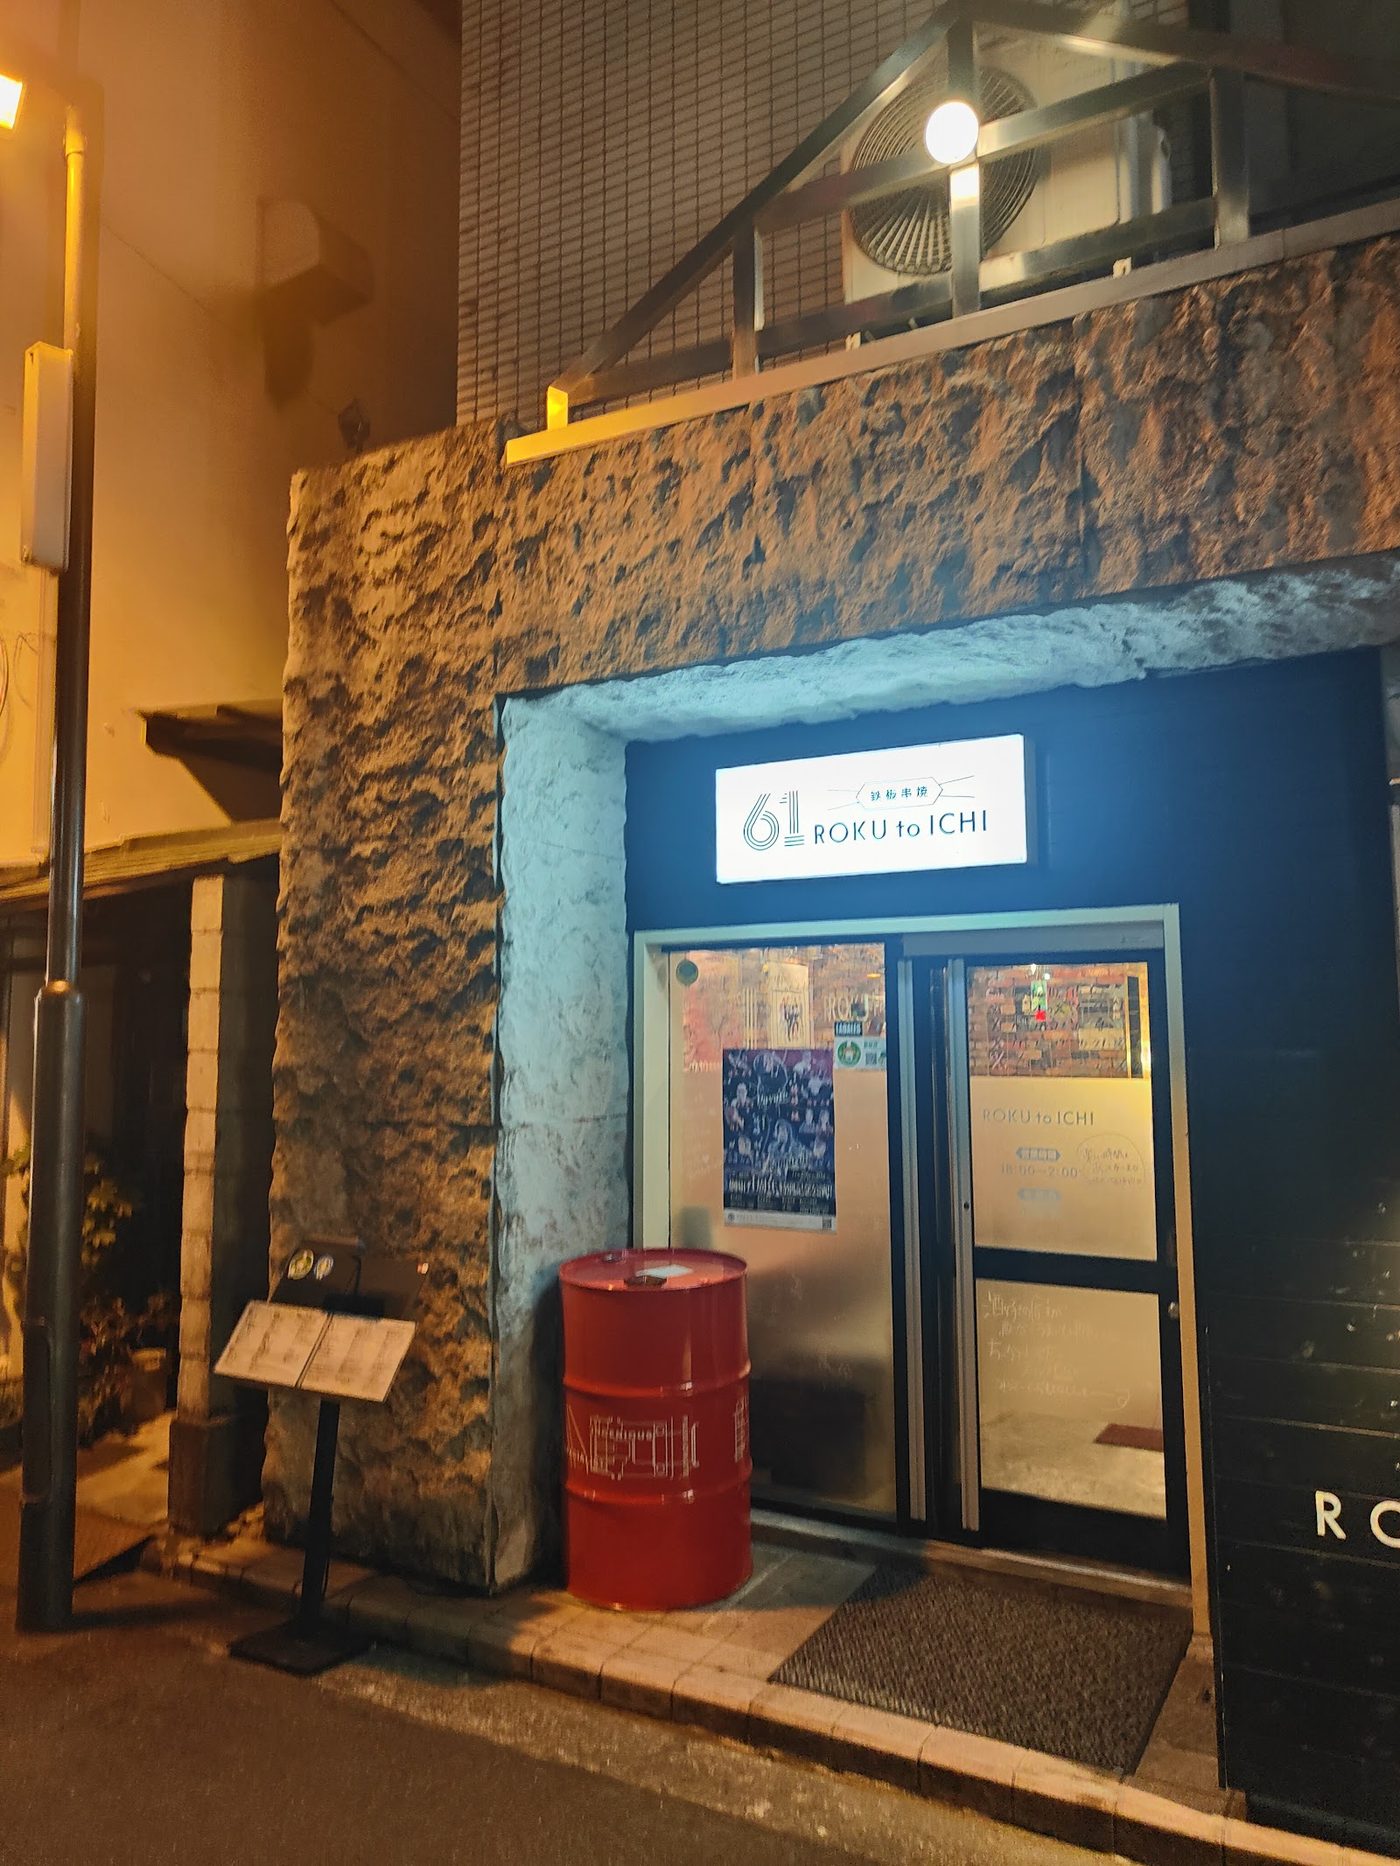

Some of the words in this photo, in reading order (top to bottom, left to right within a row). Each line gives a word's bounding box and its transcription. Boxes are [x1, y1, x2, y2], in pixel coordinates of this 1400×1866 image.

[743, 790, 804, 851] 61
[814, 819, 887, 845] ROKU
[896, 820, 920, 837] to
[930, 810, 986, 835] ICHI
[982, 1108, 1031, 1124] ROKU
[1036, 1111, 1052, 1125] to
[1057, 1110, 1094, 1126] ICHI
